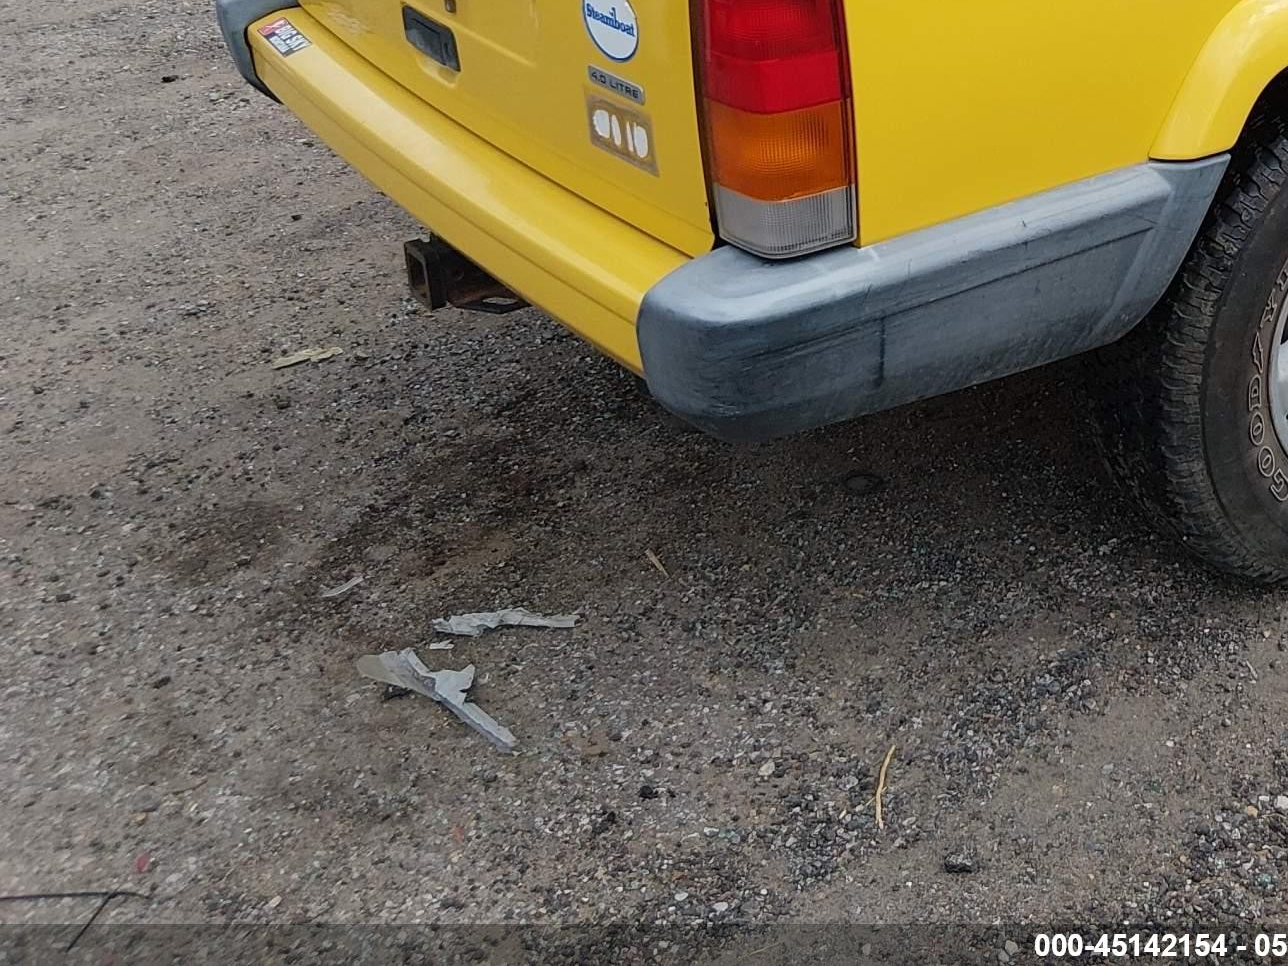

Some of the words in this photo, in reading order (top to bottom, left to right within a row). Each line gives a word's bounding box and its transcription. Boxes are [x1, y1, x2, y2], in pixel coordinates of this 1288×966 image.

[586, 2, 637, 38] Steamboat
[591, 70, 606, 85] 4.0
[610, 79, 640, 99] LITRE
